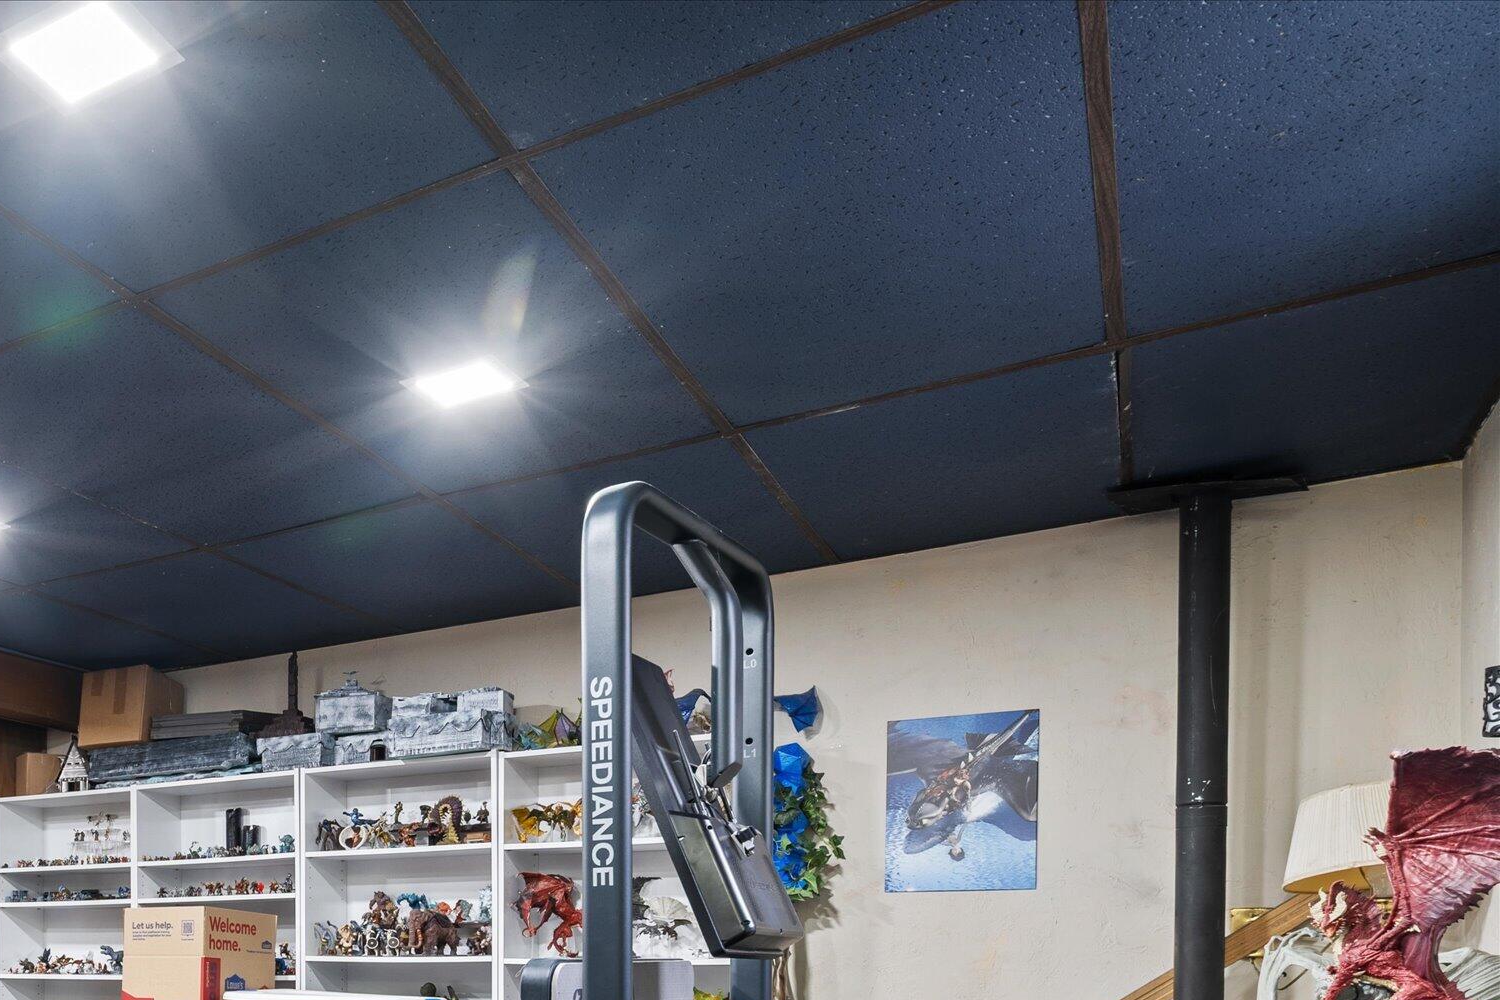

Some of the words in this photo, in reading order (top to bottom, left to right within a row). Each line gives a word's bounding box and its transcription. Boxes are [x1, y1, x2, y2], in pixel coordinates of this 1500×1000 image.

[743, 748, 757, 759] L1
[590, 676, 615, 887] SPEEDIANCE
[132, 921, 145, 930] Let
[155, 921, 174, 931] help.
[209, 916, 257, 936] Welcome
[209, 934, 241, 952] home.
